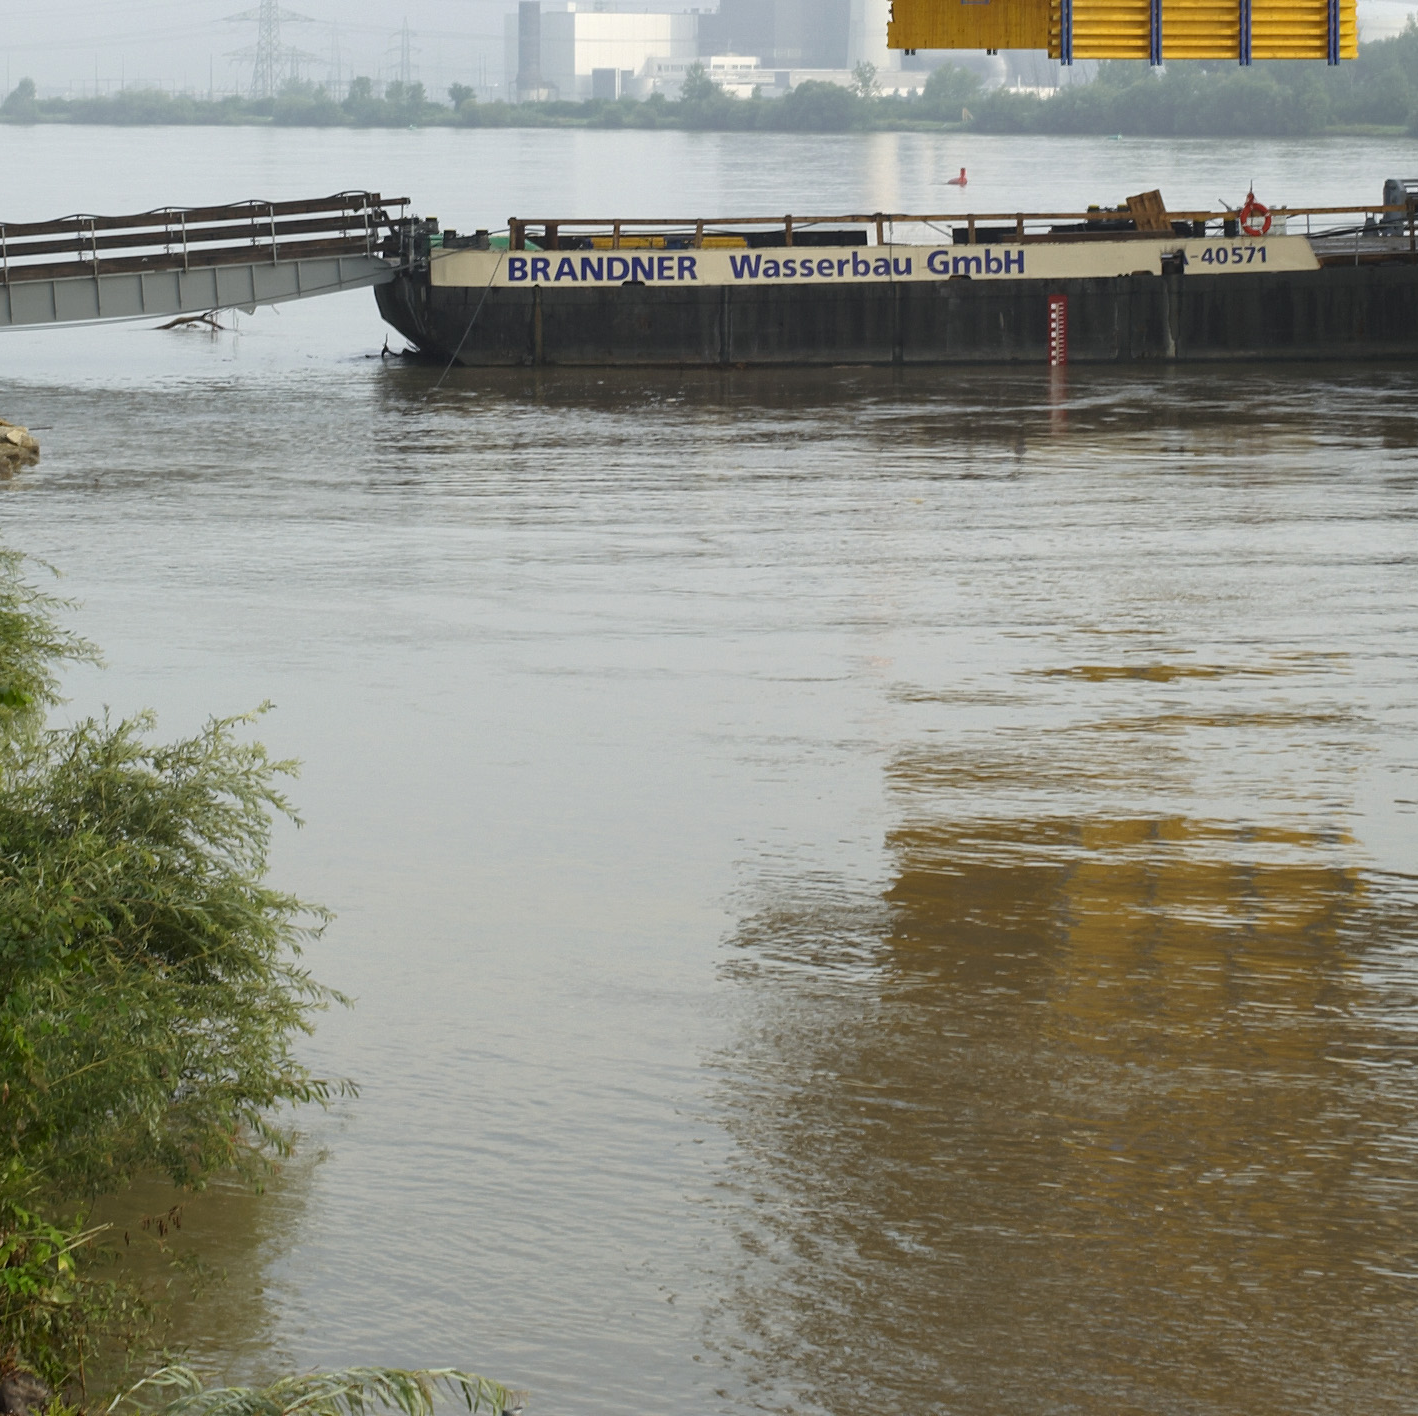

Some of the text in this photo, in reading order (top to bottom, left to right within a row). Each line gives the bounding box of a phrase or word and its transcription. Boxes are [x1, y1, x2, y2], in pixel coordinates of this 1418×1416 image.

[508, 248, 1025, 282] BRANDNER Wasserbau GmbH
